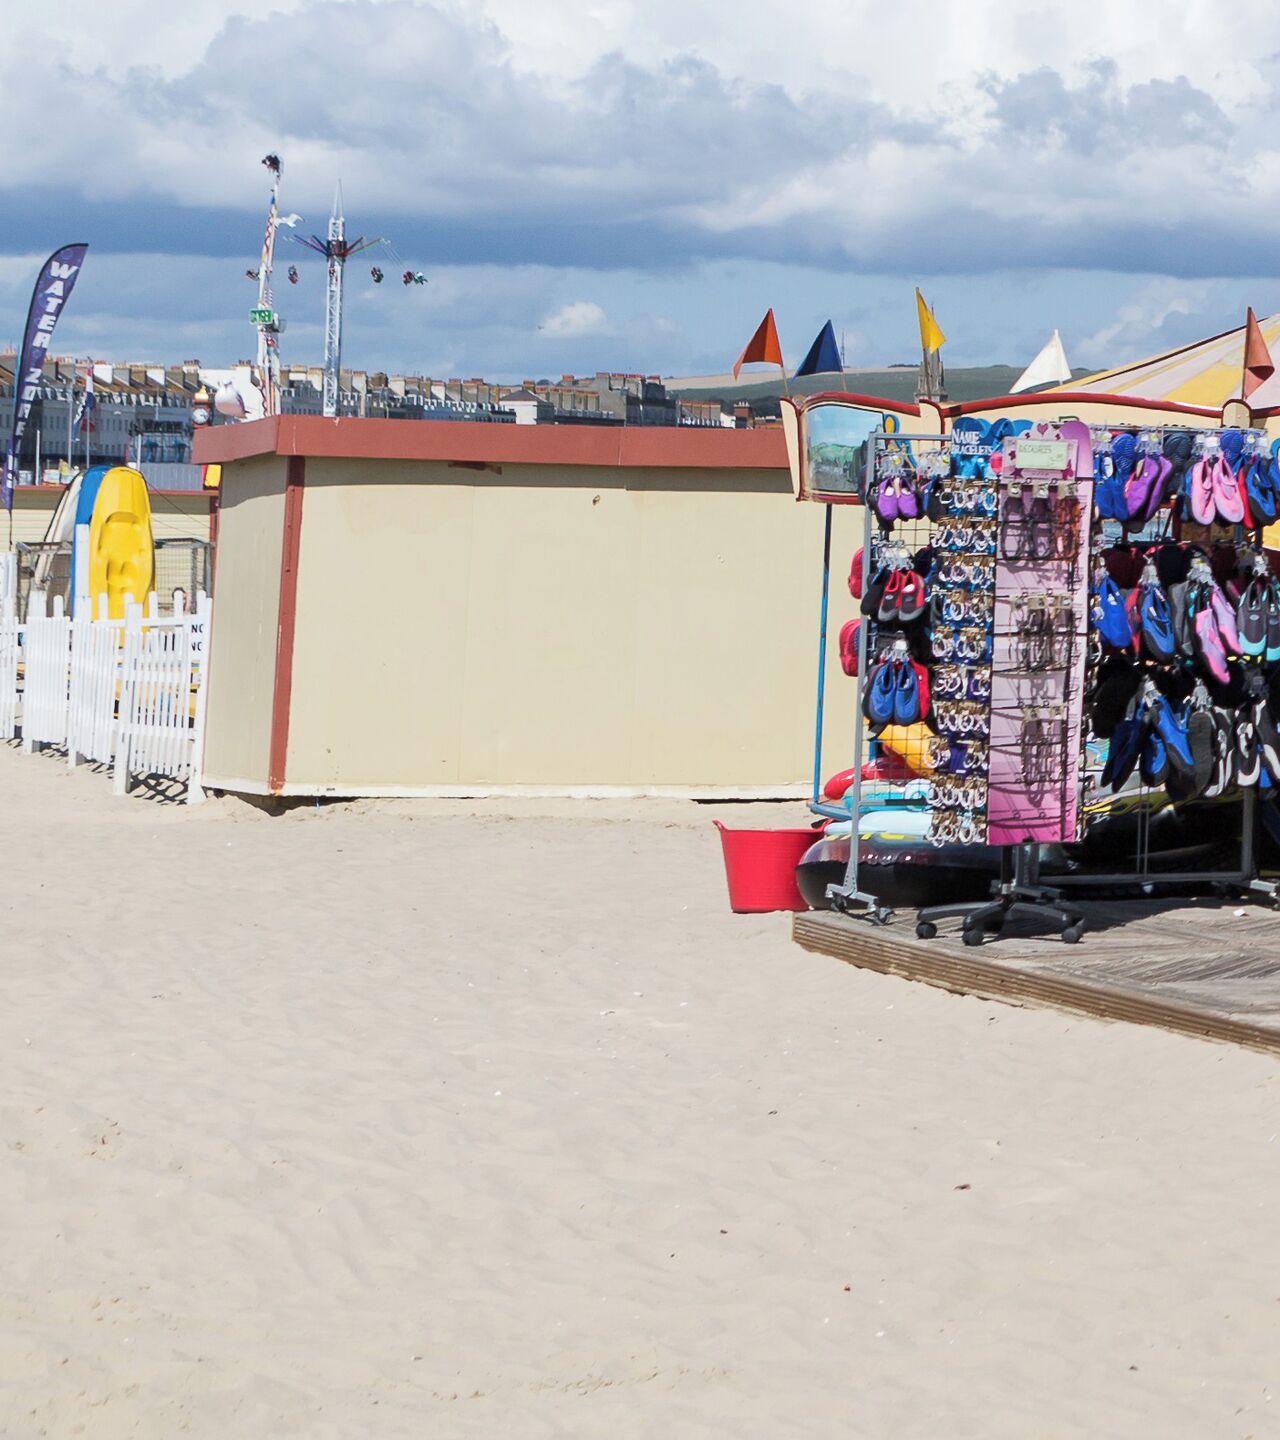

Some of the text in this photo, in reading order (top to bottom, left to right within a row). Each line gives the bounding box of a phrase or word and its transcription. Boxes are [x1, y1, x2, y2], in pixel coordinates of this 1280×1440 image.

[33, 261, 79, 349] WATER
[952, 428, 980, 444] NAME
[951, 444, 993, 456] BRACELETS
